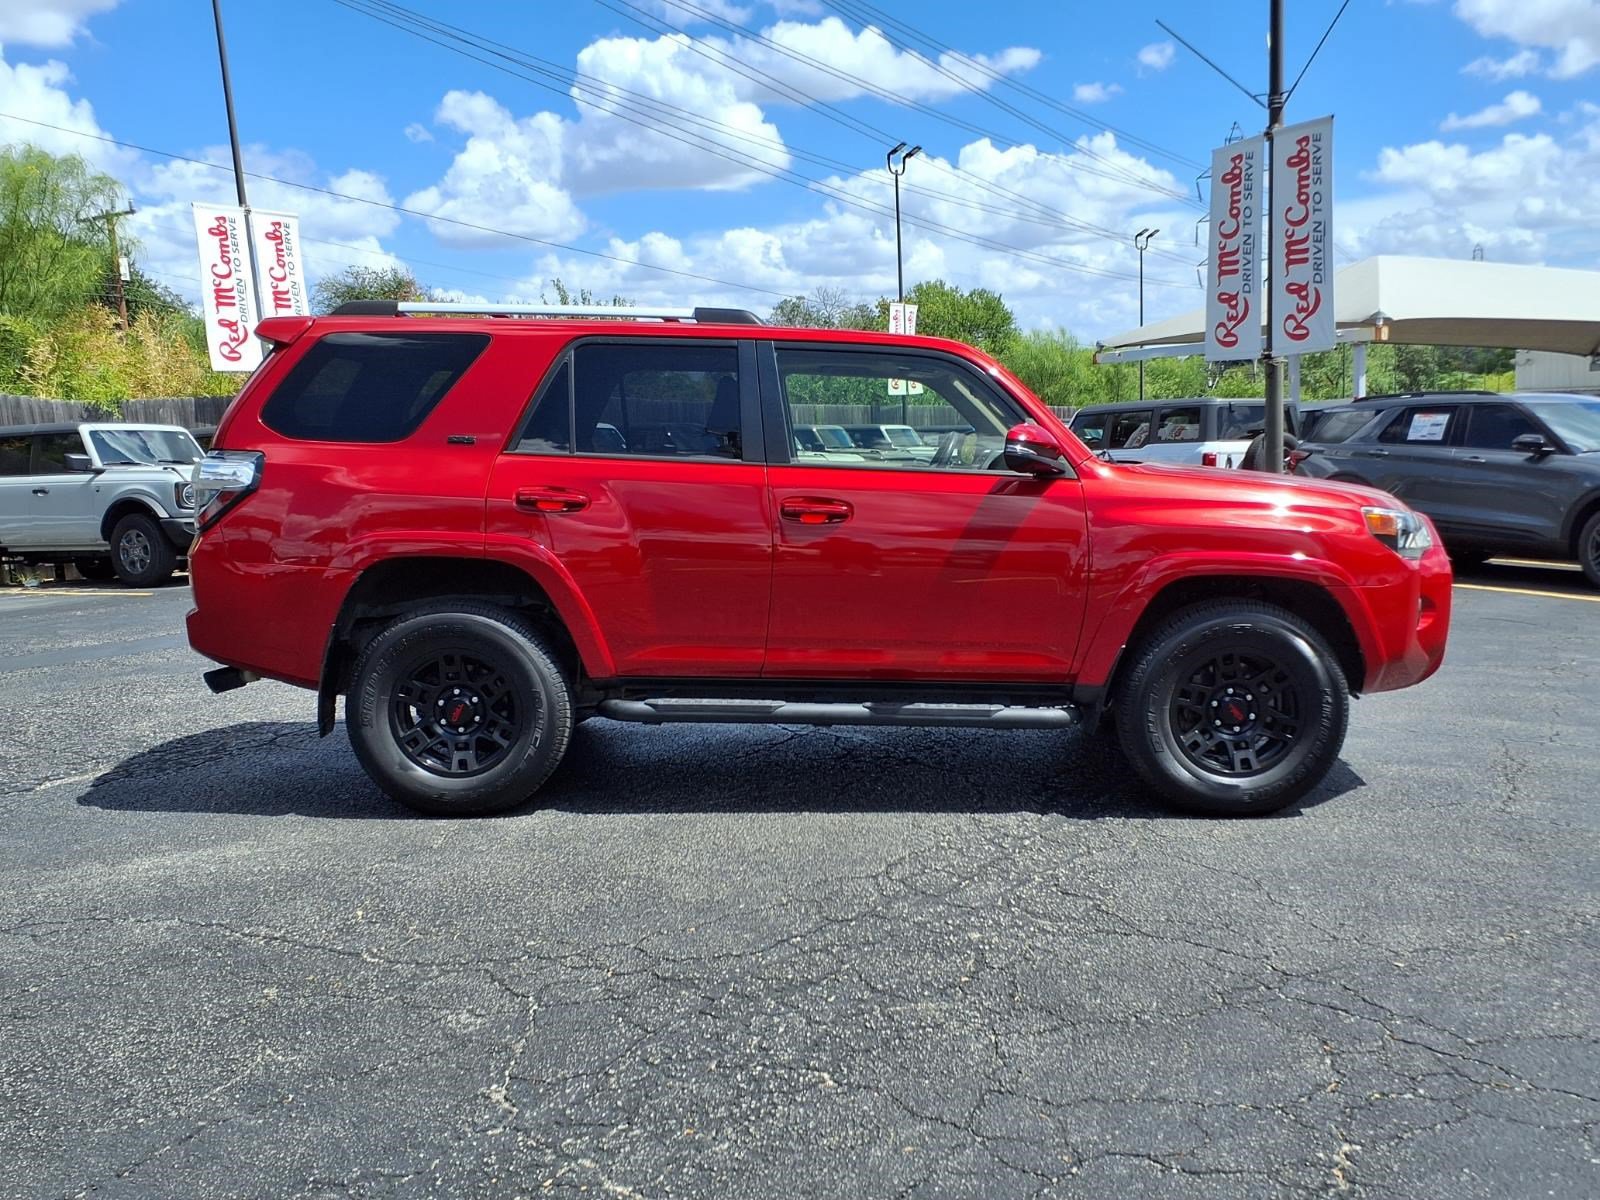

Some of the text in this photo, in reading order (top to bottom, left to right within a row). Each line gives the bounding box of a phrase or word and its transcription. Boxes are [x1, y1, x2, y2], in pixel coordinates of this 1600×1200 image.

[228, 217, 248, 323] DRIVEN TO SERVE
[265, 221, 292, 316] McCombs
[283, 222, 301, 316] RIVEN TO SERVE
[1214, 153, 1250, 348] Red McCombs
[1242, 151, 1254, 294] DRIVEN TO SERVE
[1284, 135, 1322, 341] Red McCombs
[1312, 132, 1323, 284] DRIVEN TO SERVE
[208, 215, 249, 362] Red McCombs
